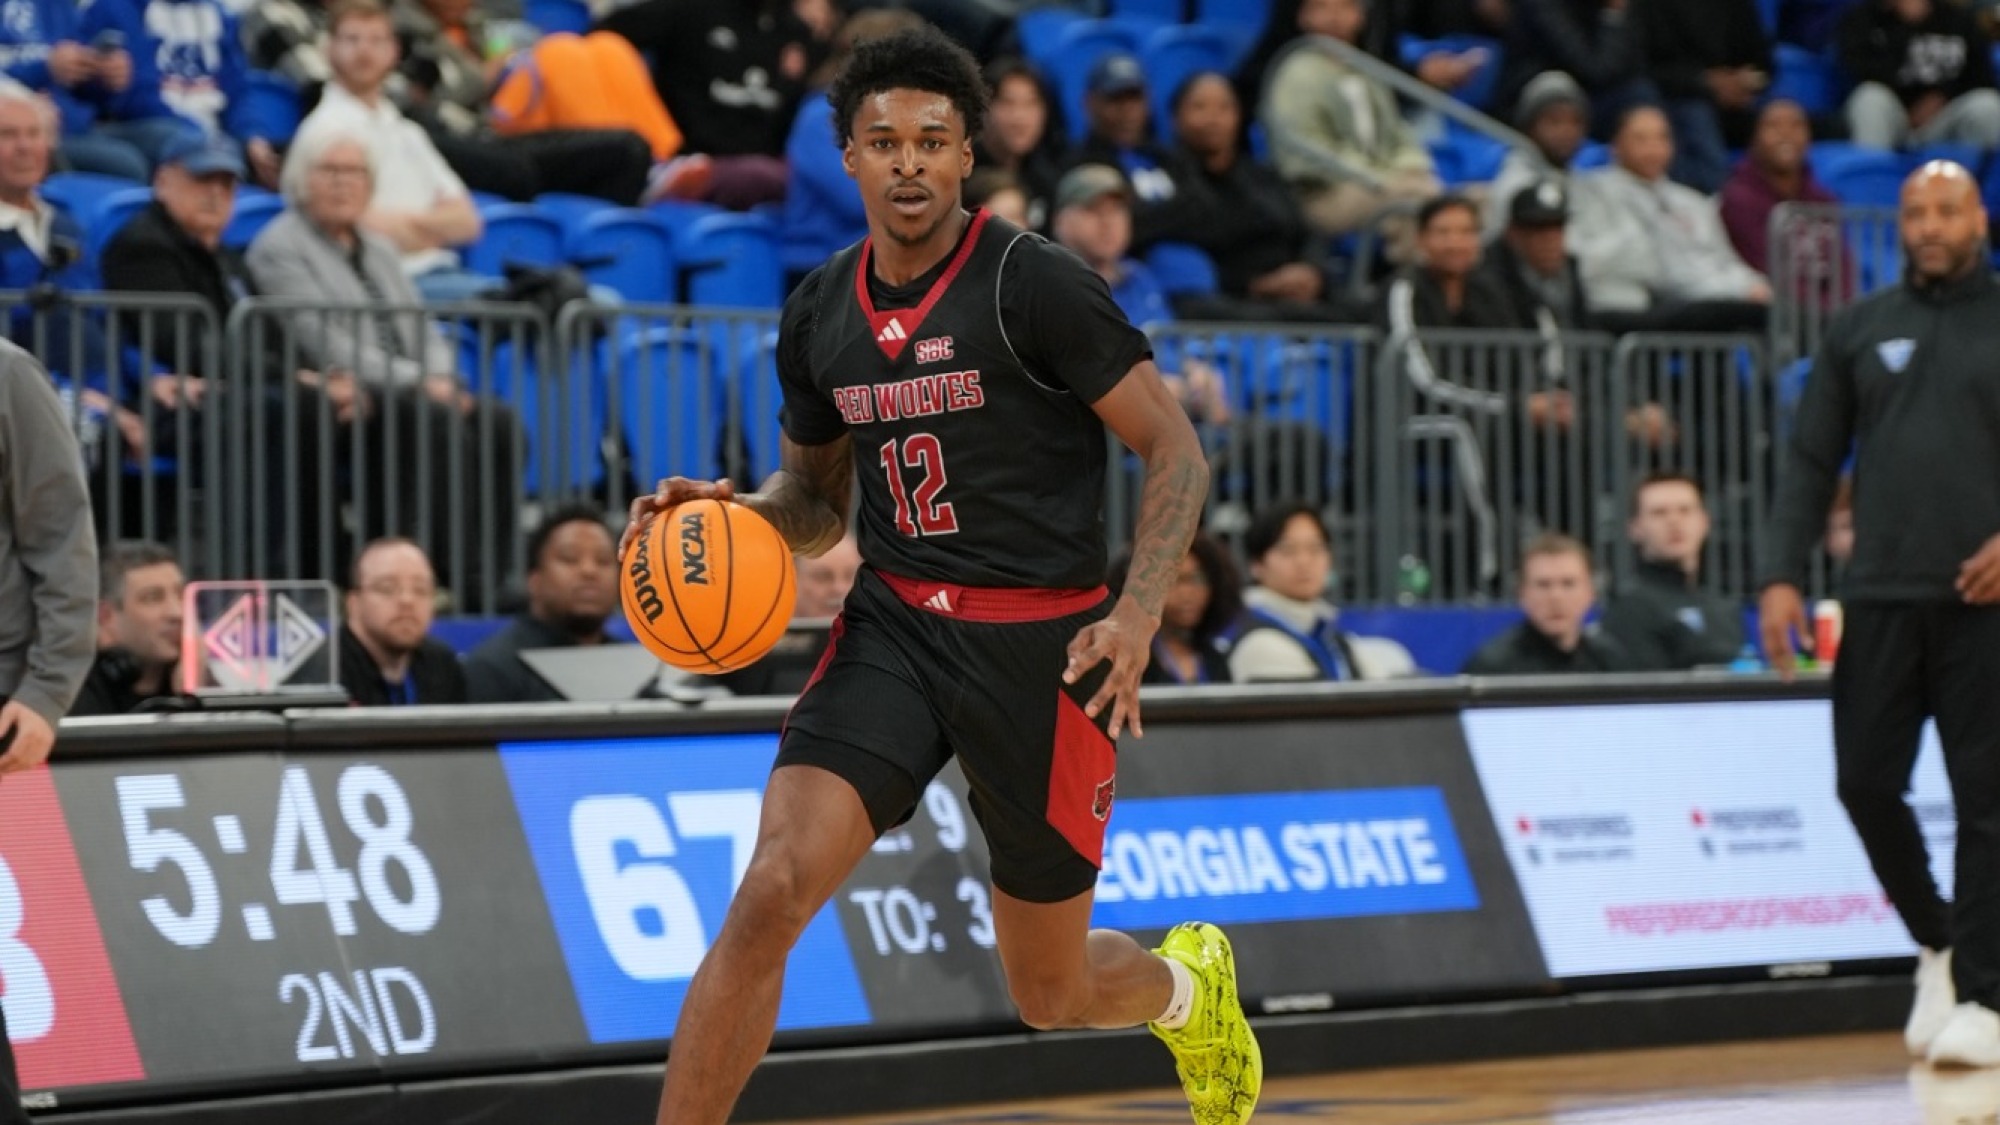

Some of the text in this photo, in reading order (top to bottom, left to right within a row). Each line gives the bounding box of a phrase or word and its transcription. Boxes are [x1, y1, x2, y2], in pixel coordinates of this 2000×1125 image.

[914, 336, 954, 364] SBC
[833, 370, 984, 424] RED WOLVES
[880, 433, 959, 537] 12
[680, 512, 709, 585] NCAA
[114, 762, 442, 949] 5:48
[925, 780, 967, 853] 9
[569, 788, 763, 981] 67
[1094, 817, 1446, 902] EORGIA STATE
[849, 877, 996, 955] TO: 3
[279, 966, 437, 1062] 2ND
